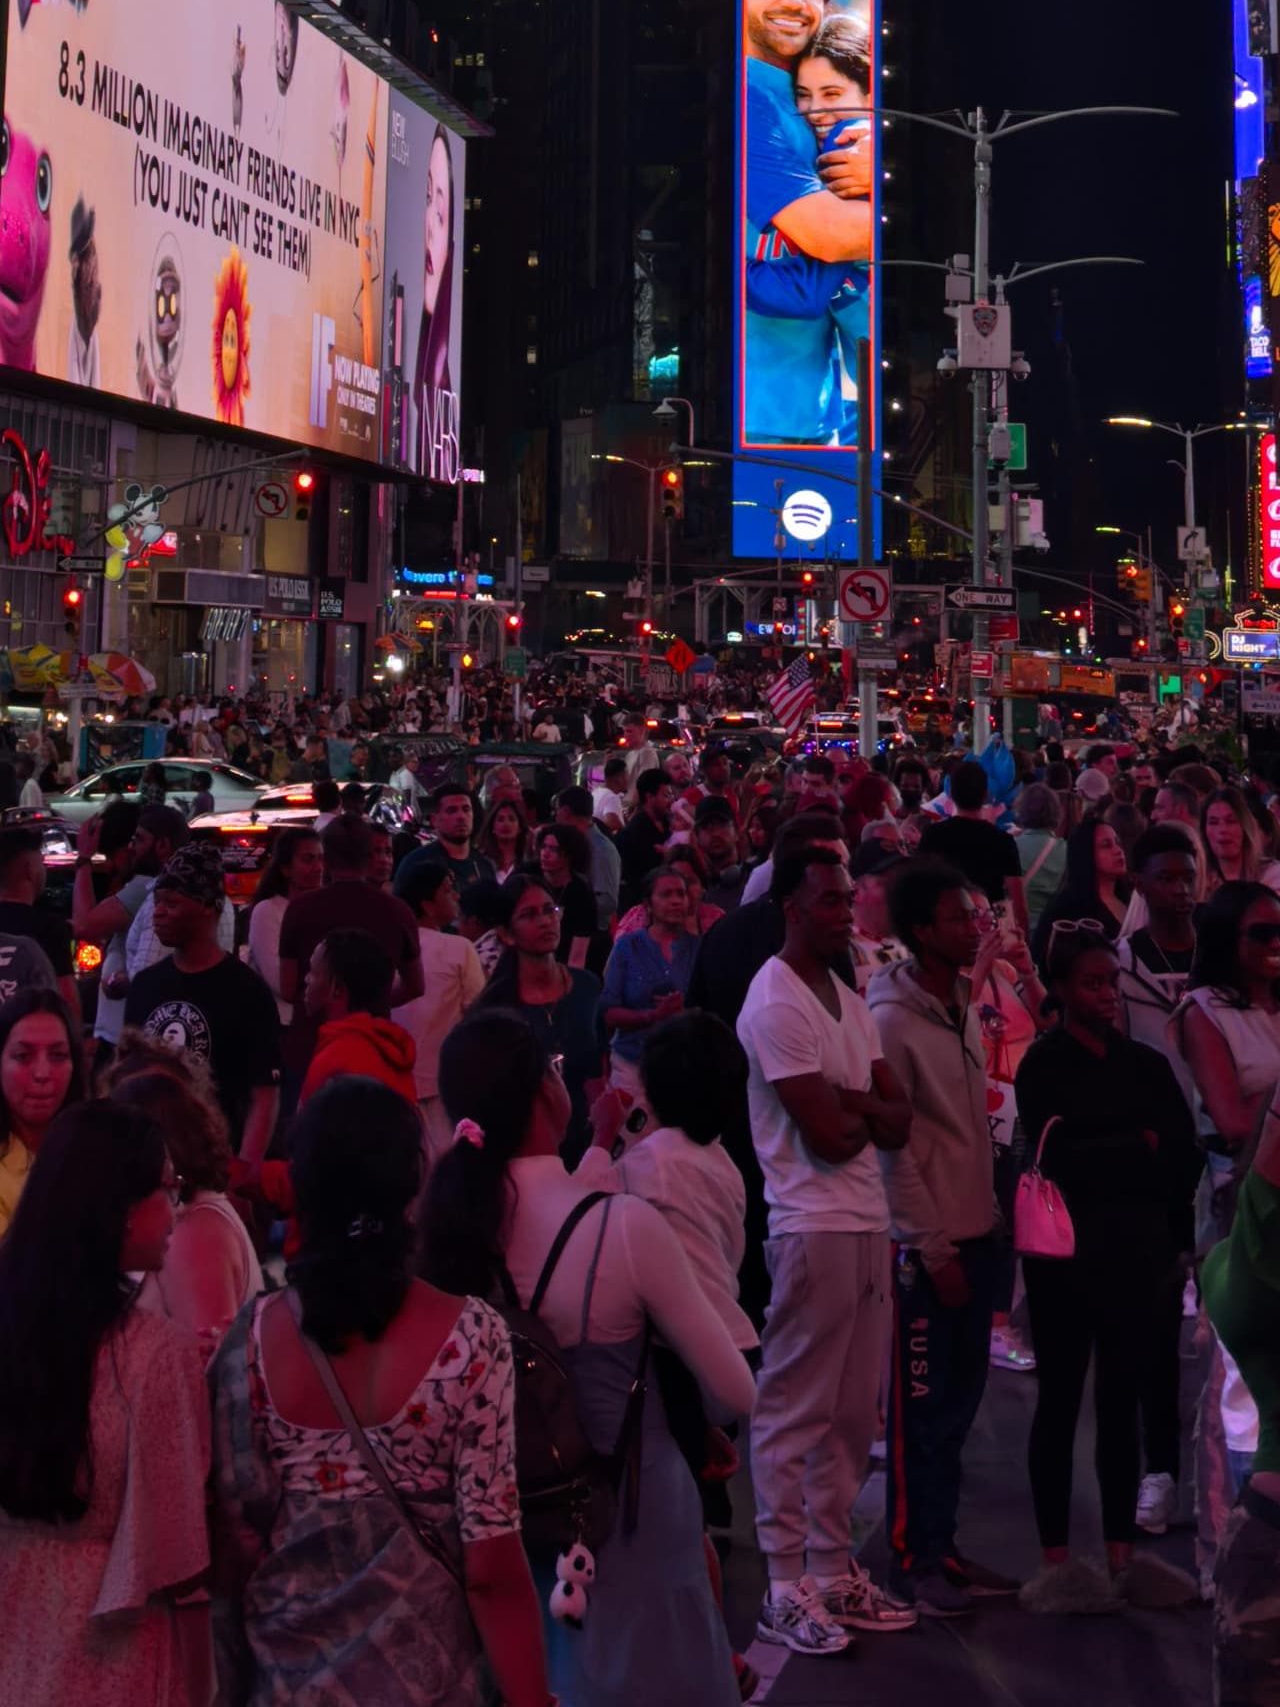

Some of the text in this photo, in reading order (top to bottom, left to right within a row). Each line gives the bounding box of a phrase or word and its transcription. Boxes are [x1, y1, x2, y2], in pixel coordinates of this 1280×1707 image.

[58, 40, 361, 249] 8.3 MILLION IMAGINARY FRIENDS LIVE IN NYC
[134, 141, 312, 284] (YOU JUST CAN'T SEE THEM)
[954, 590, 1008, 605] ONE WAY
[1231, 634, 1246, 645] DJ
[1231, 644, 1267, 654] NIGHT
